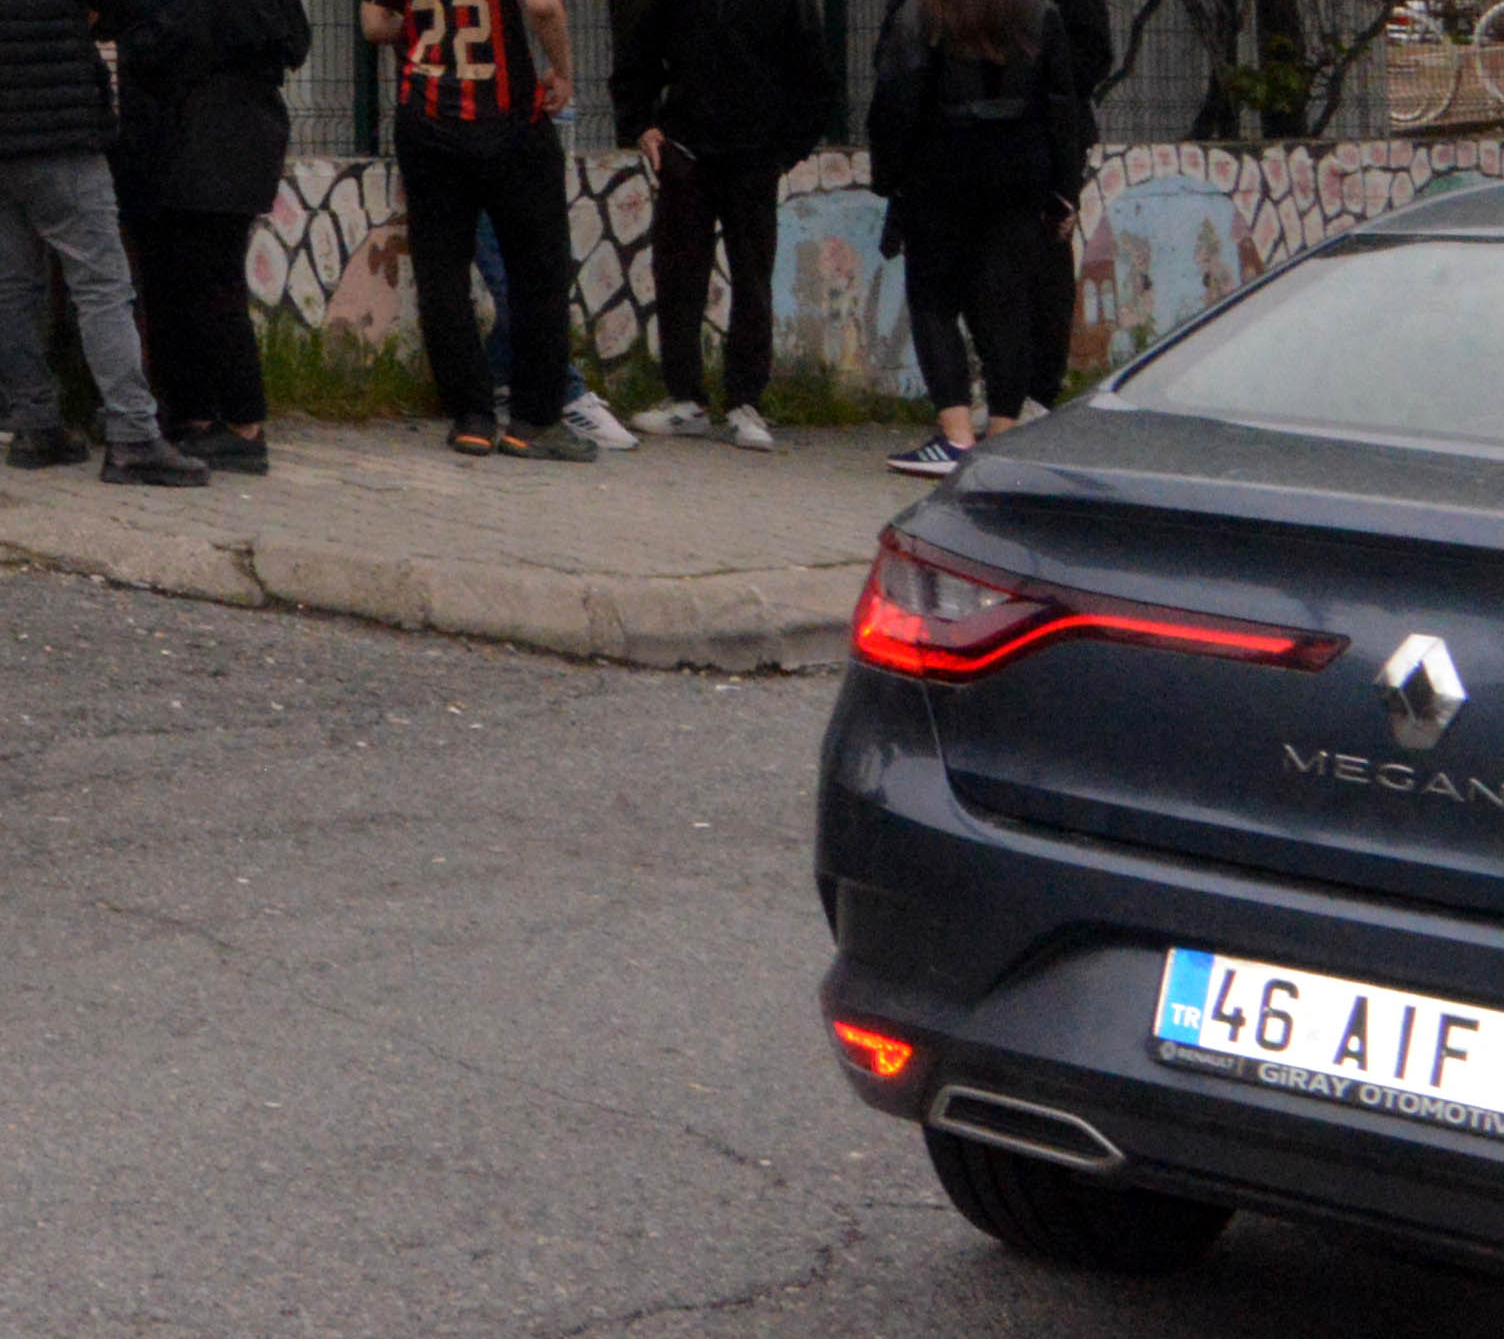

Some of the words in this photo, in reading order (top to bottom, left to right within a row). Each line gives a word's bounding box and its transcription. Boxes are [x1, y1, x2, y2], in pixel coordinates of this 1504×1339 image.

[1171, 1002, 1202, 1029] TR
[1210, 968, 1300, 1053] 46
[1332, 994, 1481, 1089] AIF
